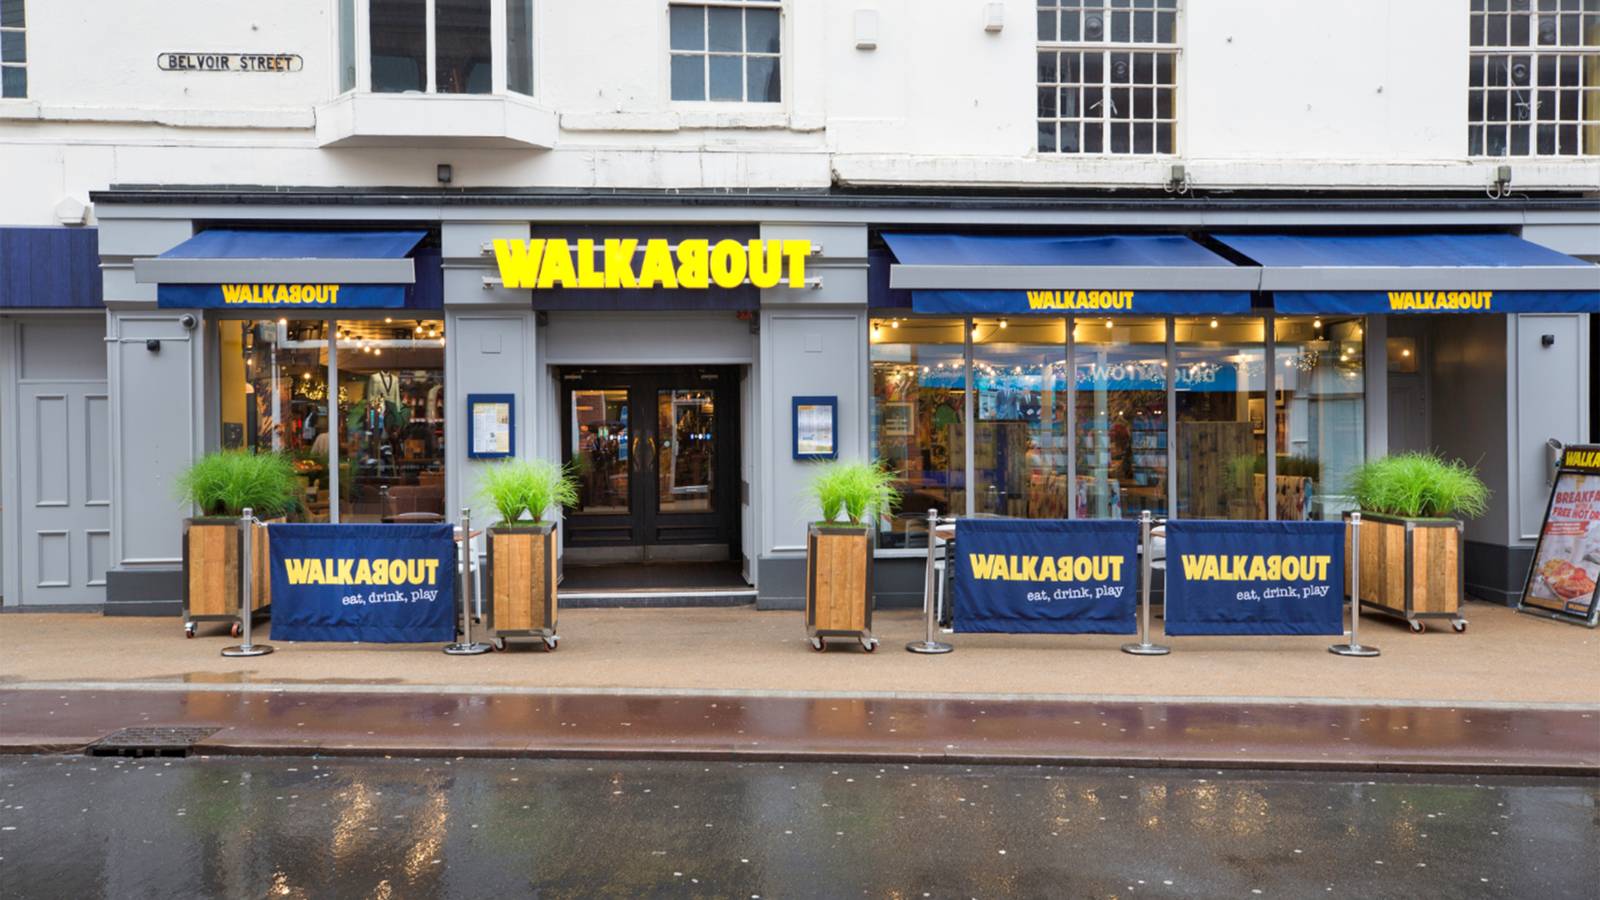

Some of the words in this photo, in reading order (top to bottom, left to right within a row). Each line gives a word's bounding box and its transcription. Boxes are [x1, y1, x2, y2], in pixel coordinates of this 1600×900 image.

[168, 55, 230, 69] BELVOIR
[240, 56, 293, 70] STREET
[492, 239, 812, 289] WALKABOUT
[221, 284, 340, 304] WALKABOUT
[1026, 291, 1135, 310] WALKABOUT
[1388, 291, 1493, 310] WALKABOUT
[284, 558, 439, 585] WALKABOUT
[969, 553, 1125, 582] WALKABOUT
[1181, 554, 1331, 581] WALKABOUT
[342, 593, 366, 605] eat,
[368, 590, 408, 603] drink,
[411, 589, 439, 602] play
[1027, 590, 1051, 602] eat,
[1053, 586, 1093, 600] drink,
[1095, 585, 1125, 598] play
[1236, 590, 1260, 602] eat,
[1263, 586, 1300, 600] drink,
[1303, 585, 1330, 598] play
